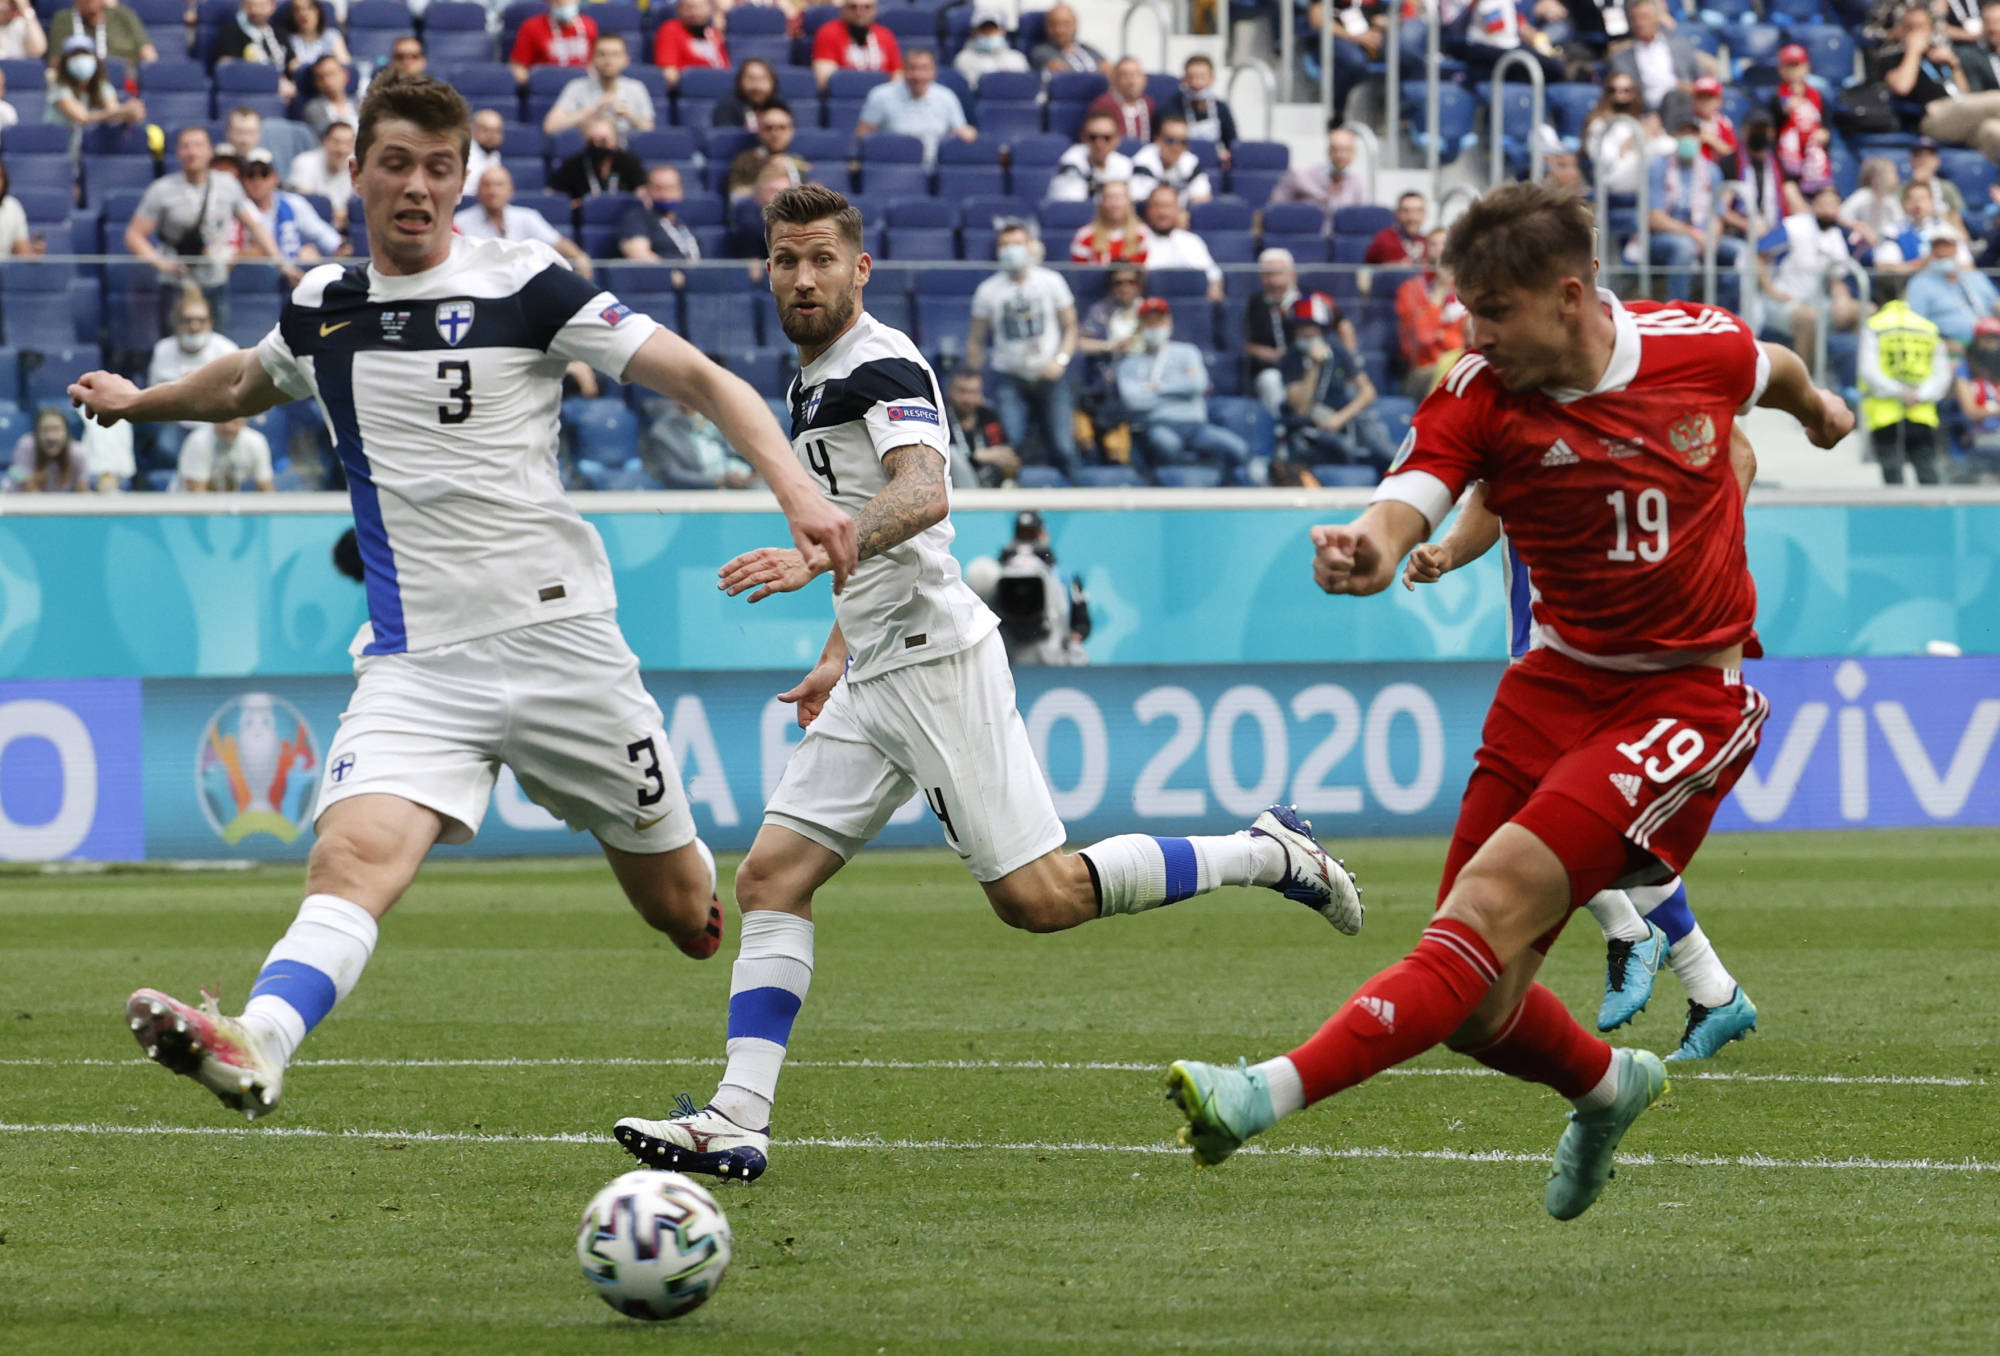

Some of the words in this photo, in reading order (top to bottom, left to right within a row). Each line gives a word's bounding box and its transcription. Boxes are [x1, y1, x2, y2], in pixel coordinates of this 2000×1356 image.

[437, 360, 473, 424] 3
[903, 409, 938, 421] RESPECT
[805, 438, 840, 496] 4
[1606, 487, 1669, 563] 19
[627, 736, 666, 807] 3
[1132, 683, 1445, 818] 2020
[1615, 717, 1705, 784] 19
[924, 786, 960, 843] 4
